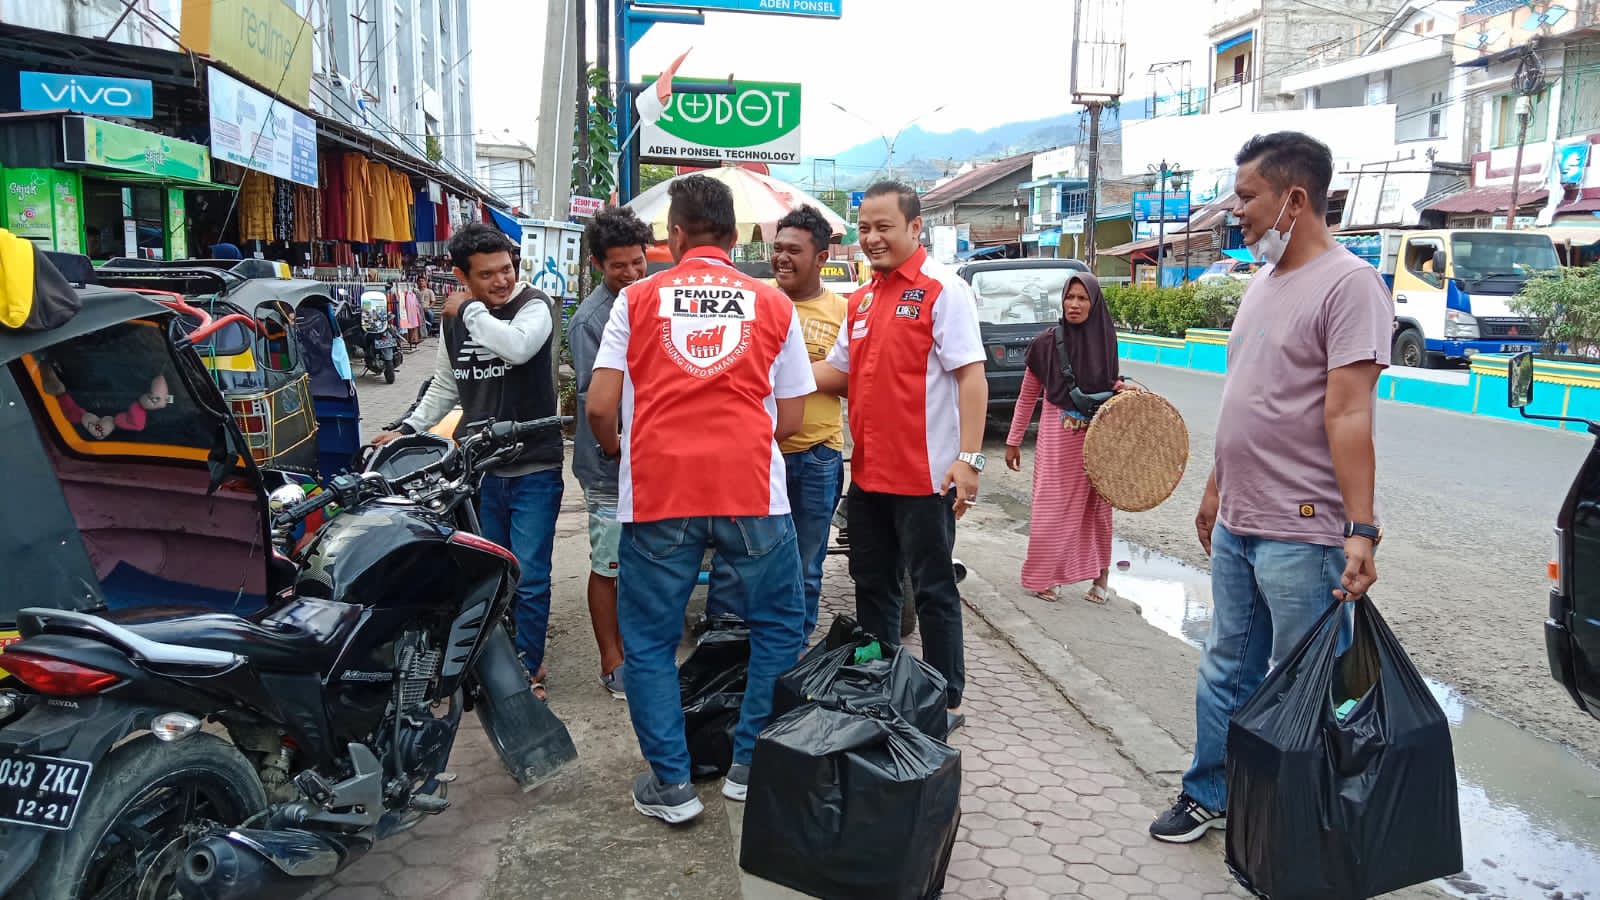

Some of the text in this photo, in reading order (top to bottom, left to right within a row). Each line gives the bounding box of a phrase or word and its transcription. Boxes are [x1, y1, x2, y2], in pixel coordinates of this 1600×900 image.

[759, 0, 834, 12] ADEN PONSEL
[240, 6, 292, 70] realme
[41, 79, 132, 106] vivo
[648, 145, 796, 161] ADEN PONSEL TECHNOLOGY
[674, 289, 745, 300] PEMUDA
[662, 321, 684, 365] LUMBUNG
[734, 324, 751, 356] RAKYAT
[452, 368, 470, 380] ew
[39, 763, 80, 796] ZKL
